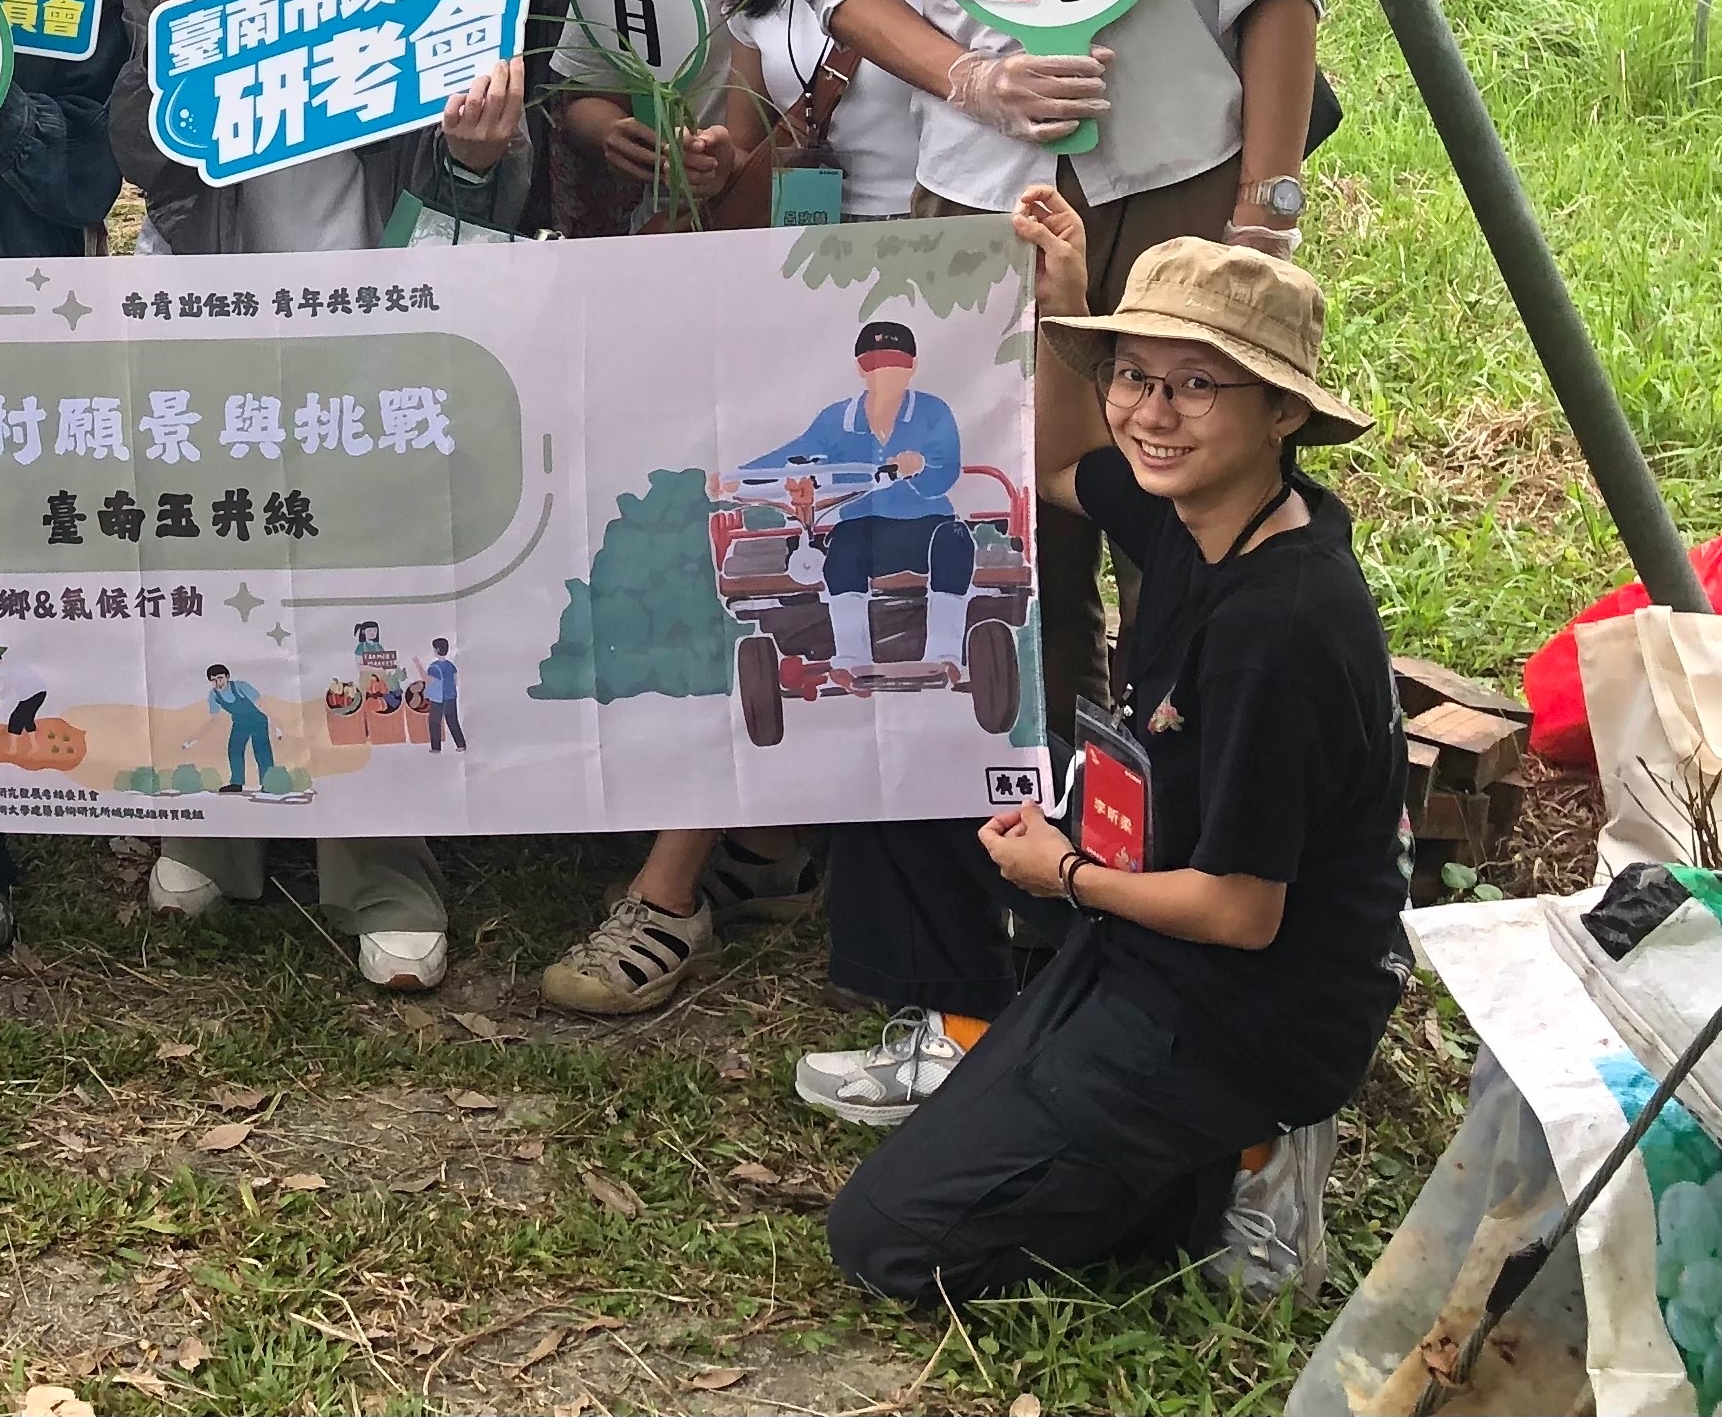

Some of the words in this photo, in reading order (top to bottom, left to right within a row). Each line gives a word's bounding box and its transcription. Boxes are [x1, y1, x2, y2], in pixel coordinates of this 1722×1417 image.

[121, 291, 259, 319] 南青出任務
[271, 284, 440, 318] 青年共學交流
[41, 489, 320, 546] 臺南玉井線
[994, 774, 1035, 797] 廣告
